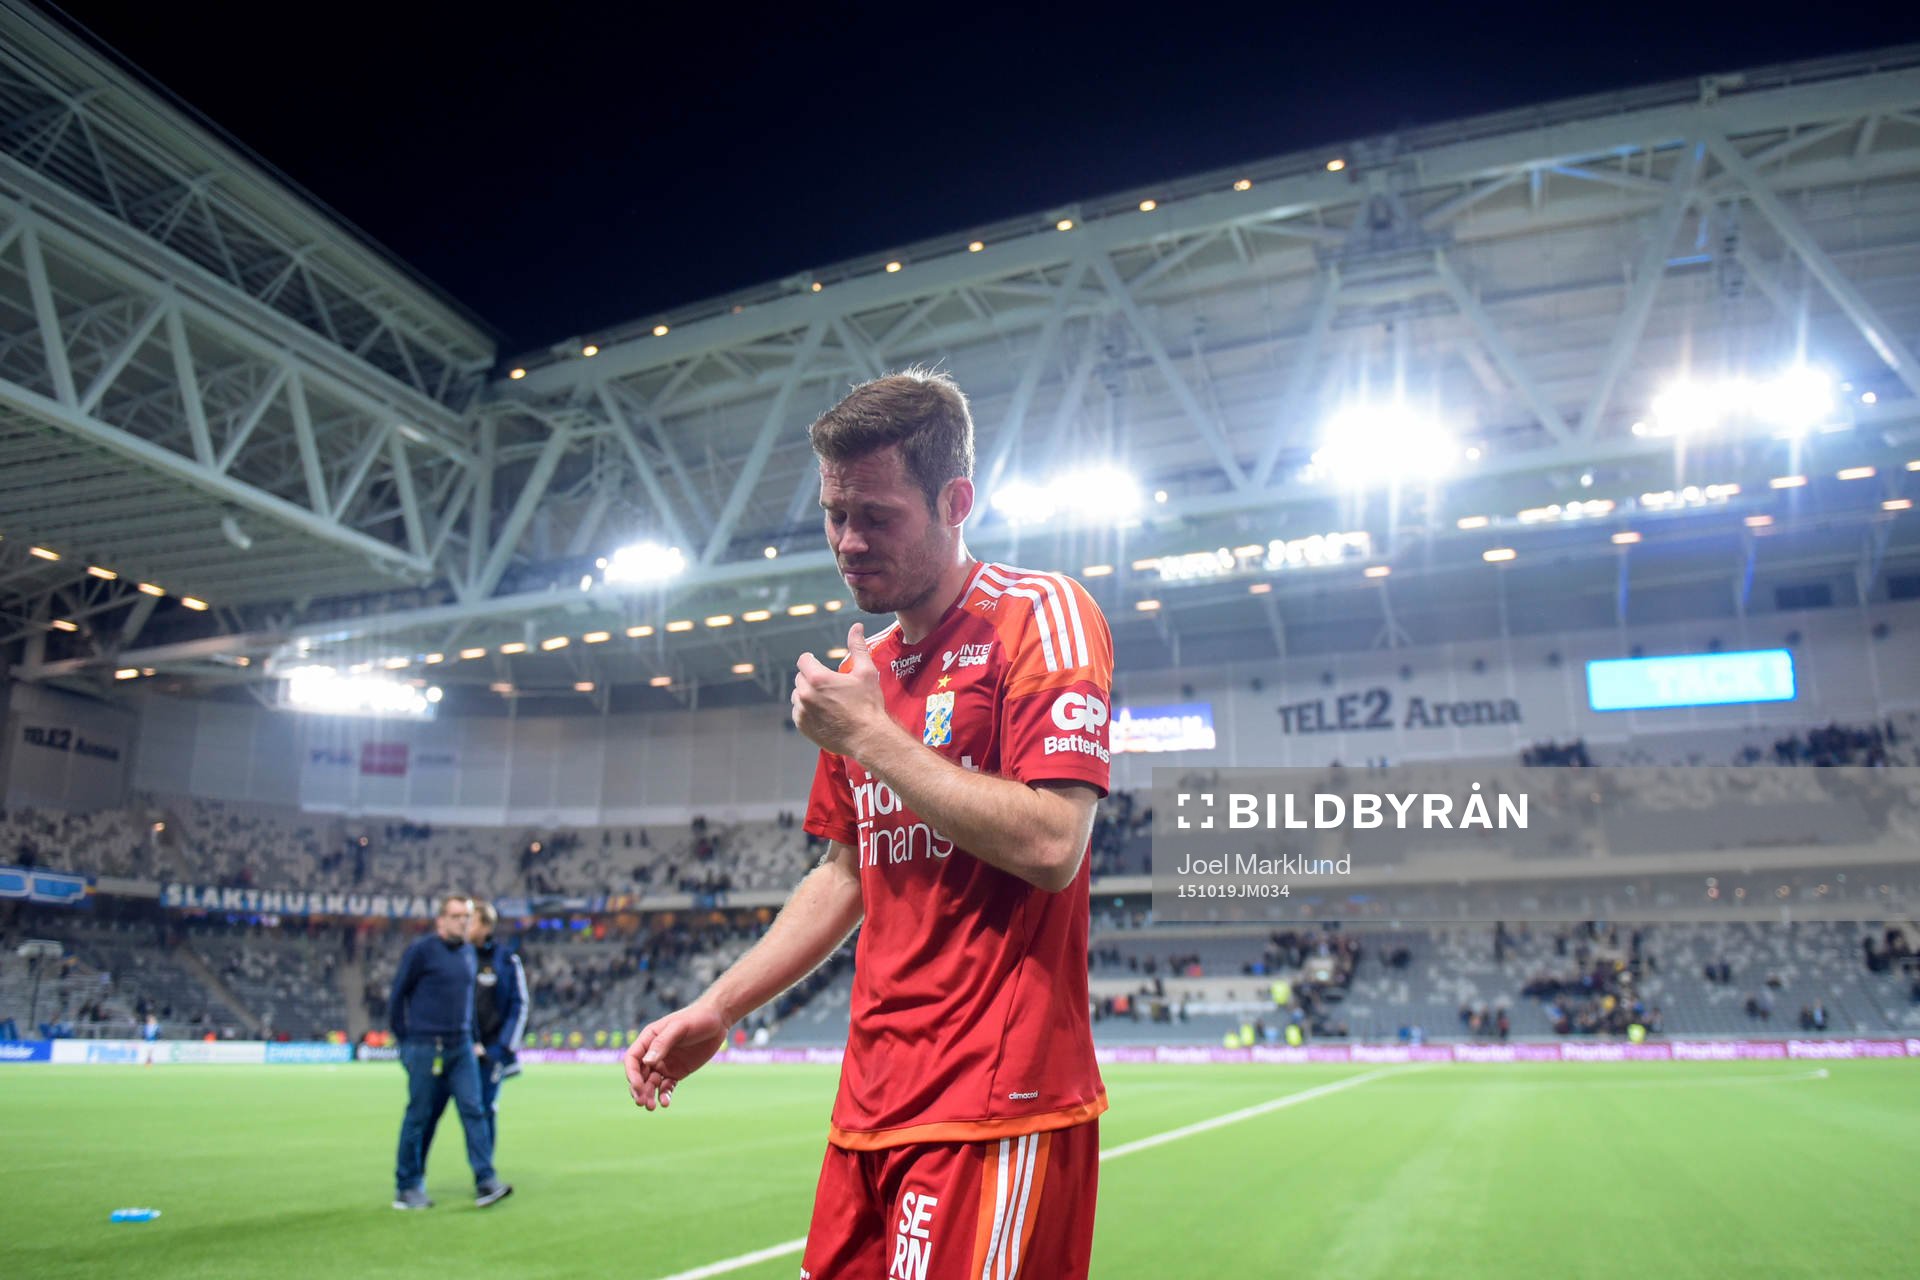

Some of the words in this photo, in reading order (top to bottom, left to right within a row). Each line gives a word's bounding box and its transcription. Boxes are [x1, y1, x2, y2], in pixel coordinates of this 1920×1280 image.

[958, 654, 990, 668] SPOR
[1051, 691, 1108, 734] GP
[1278, 686, 1394, 734] TELE2
[1404, 696, 1522, 730] Arena
[857, 820, 954, 869] Finans
[899, 1191, 938, 1239] SE
[889, 1233, 932, 1280] RN
